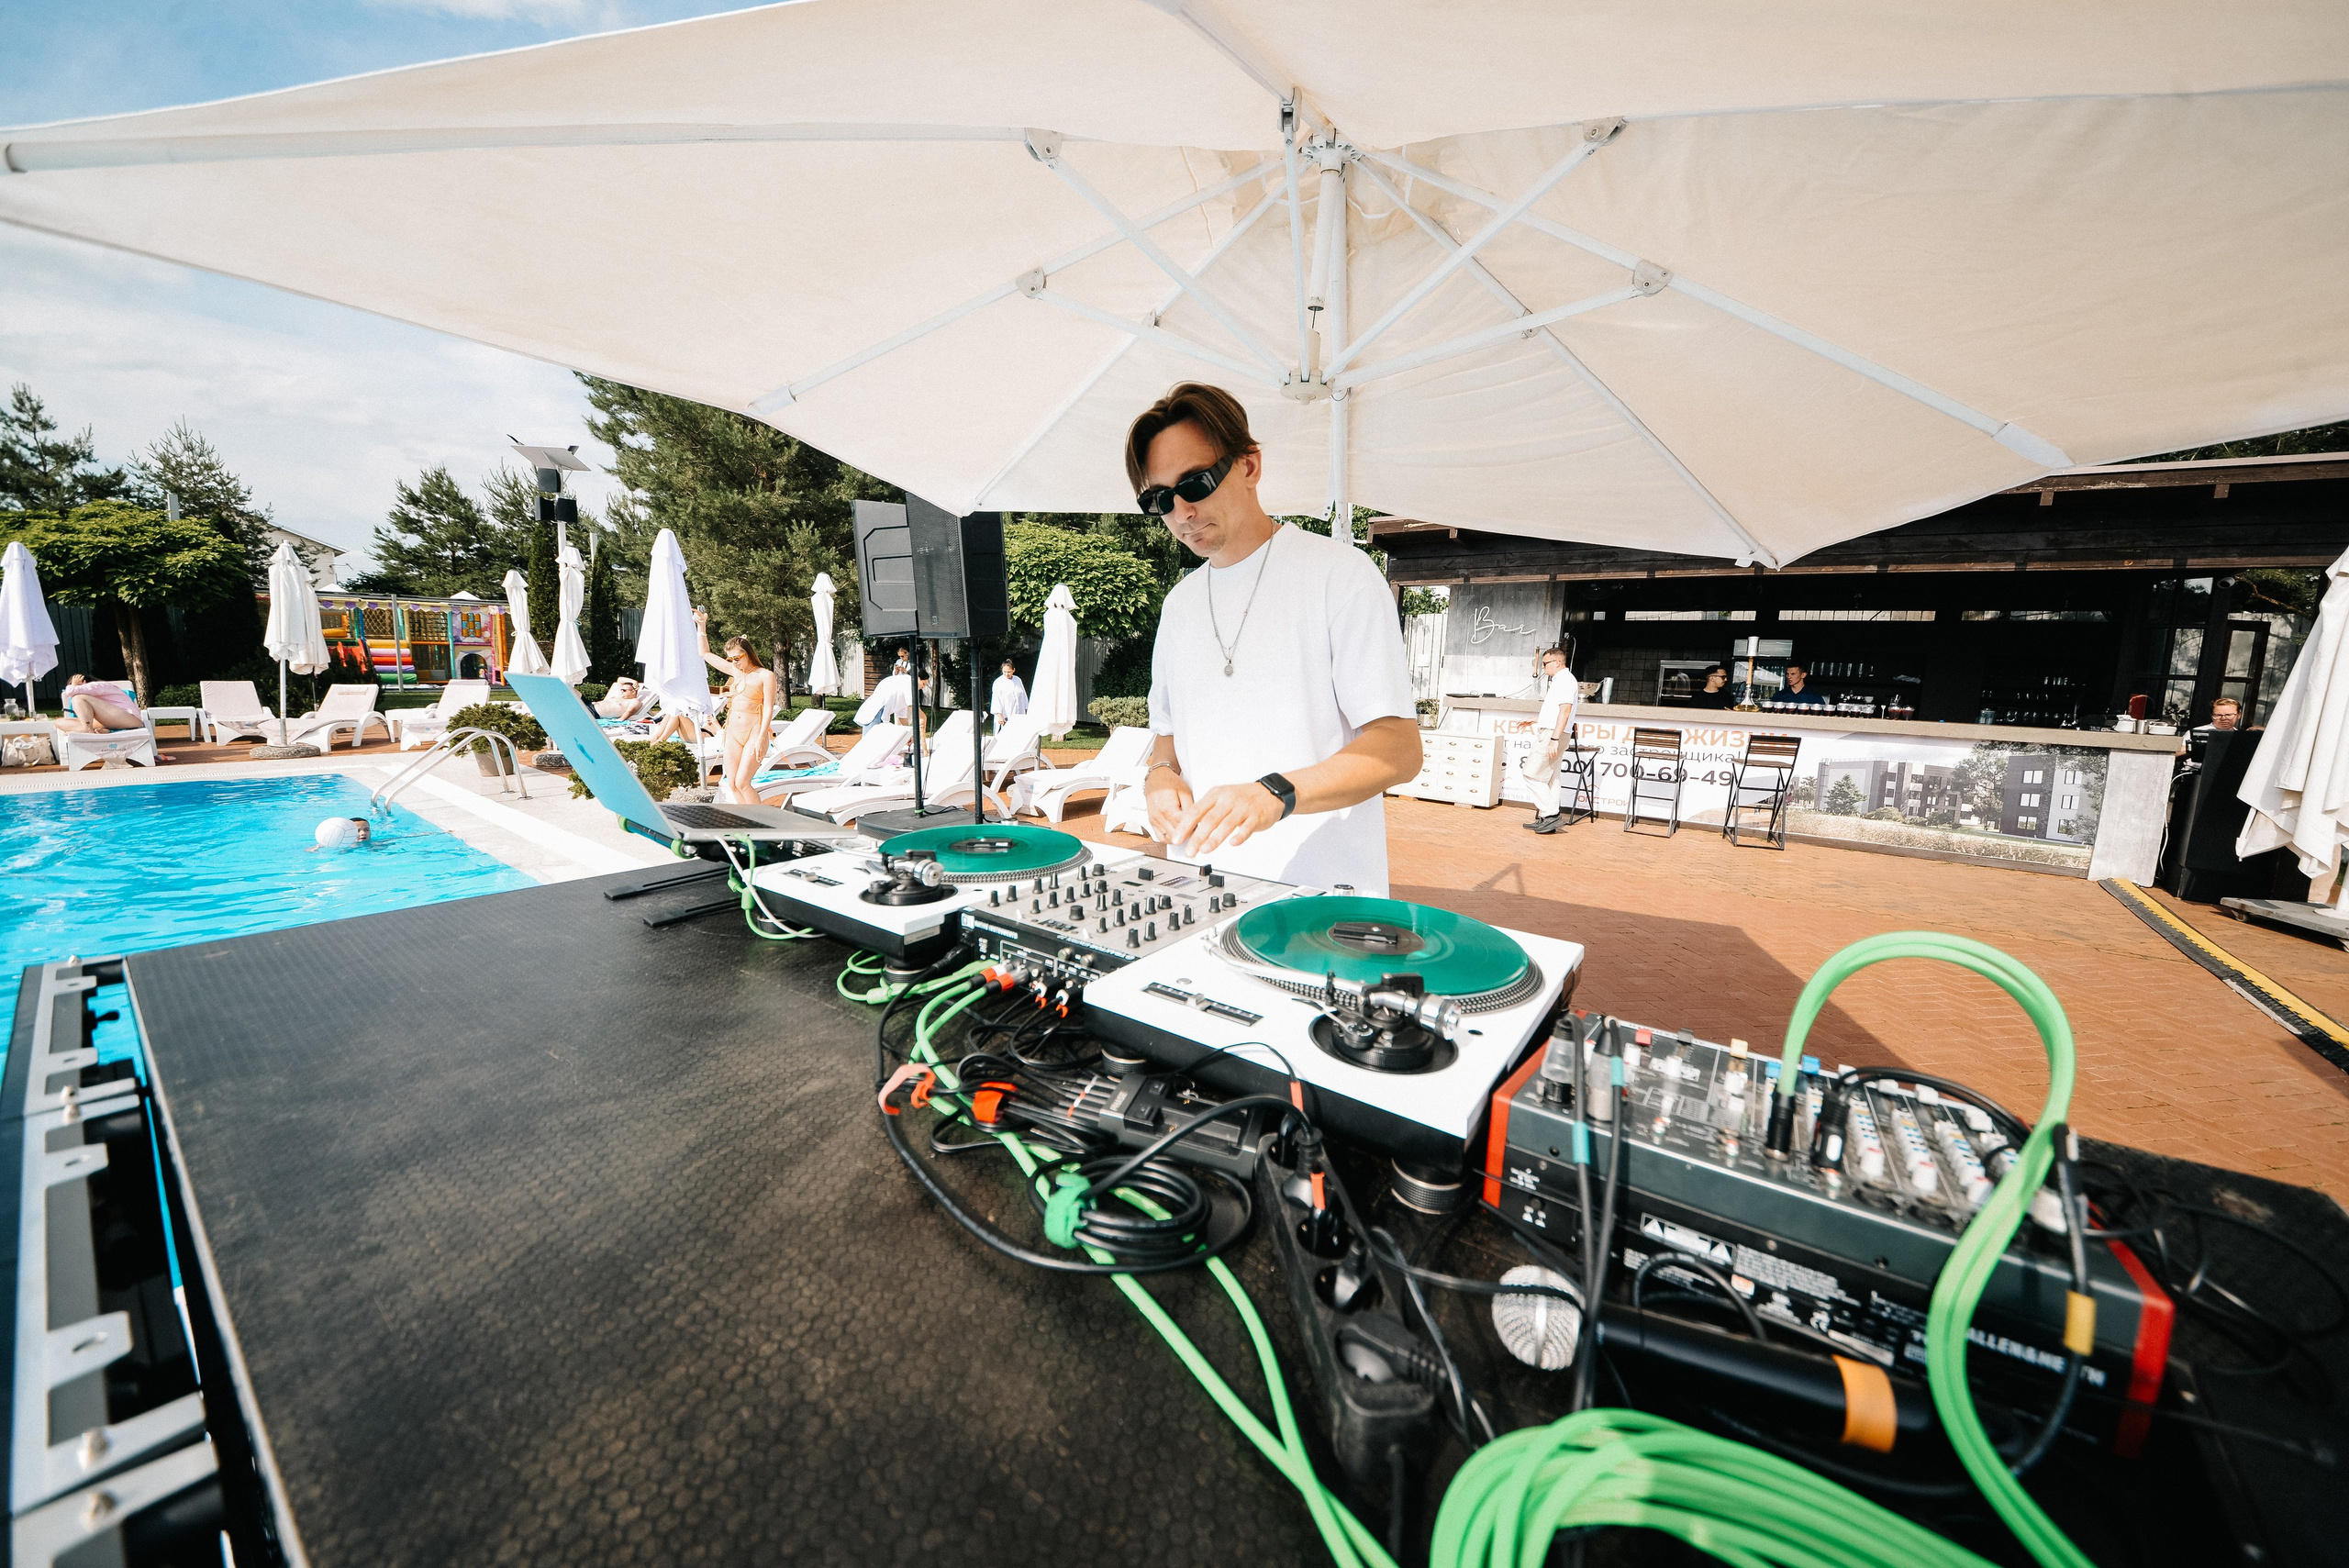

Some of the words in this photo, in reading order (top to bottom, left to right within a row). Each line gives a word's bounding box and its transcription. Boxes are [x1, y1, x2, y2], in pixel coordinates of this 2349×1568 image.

[1470, 606, 1537, 644] Bar
[1493, 718, 1616, 740] КВАРЫ
[1684, 728, 1788, 750] ЖИЗ
